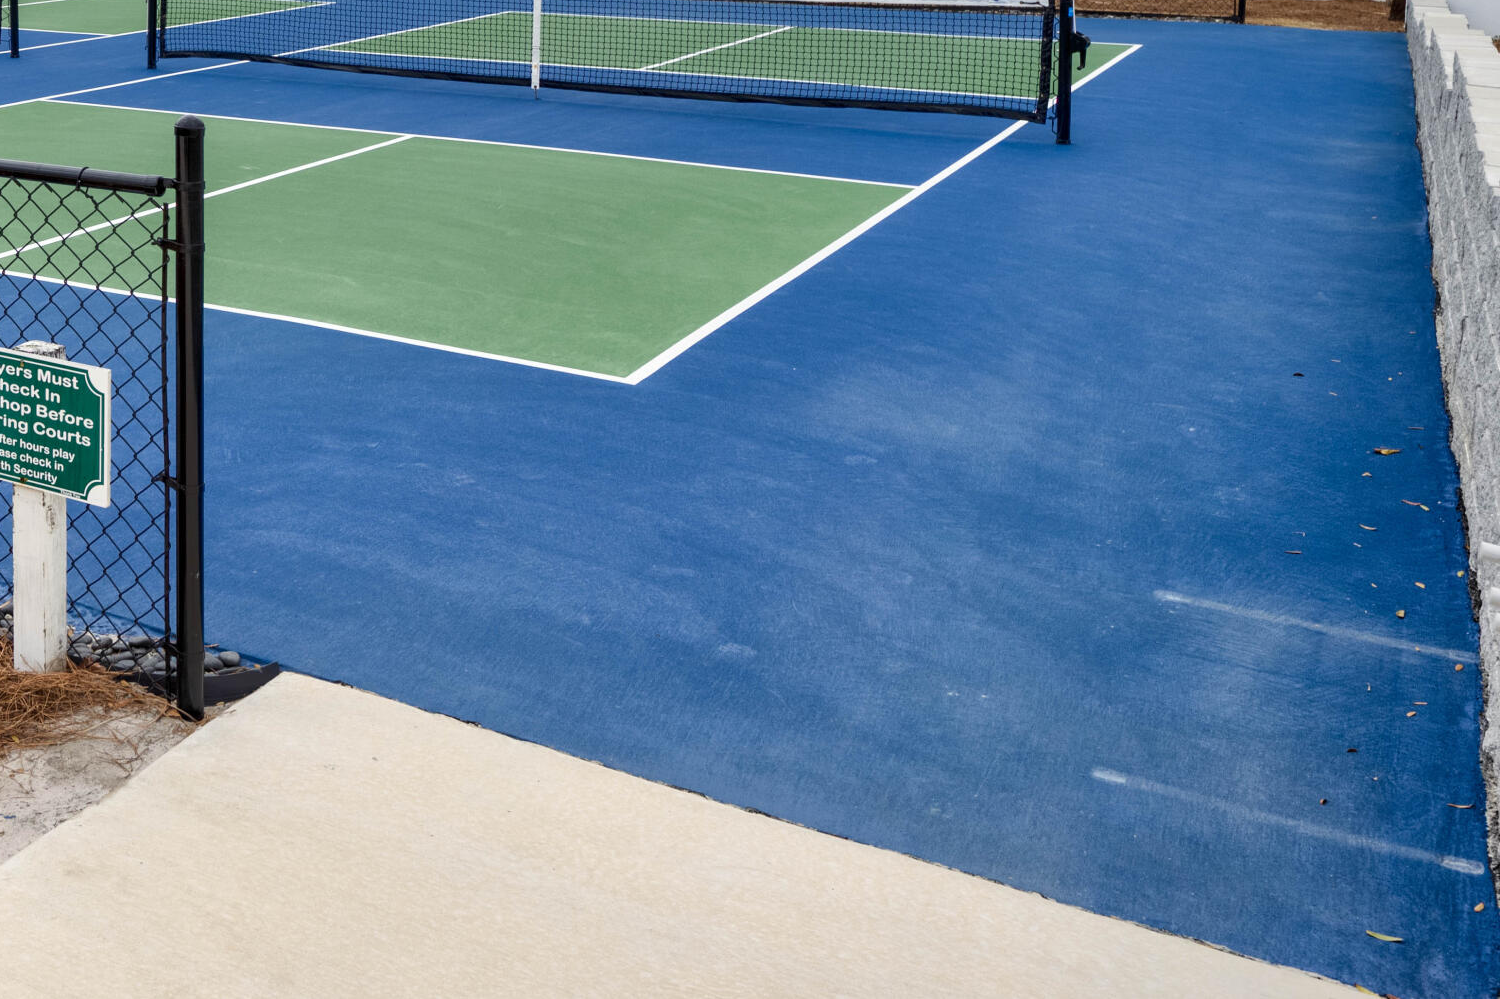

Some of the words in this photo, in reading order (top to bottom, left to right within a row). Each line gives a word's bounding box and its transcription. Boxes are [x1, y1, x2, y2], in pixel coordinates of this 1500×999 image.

[38, 369, 79, 389] Must
[46, 388, 60, 403] In
[36, 405, 93, 429] Before
[33, 423, 91, 446] Courts
[20, 439, 49, 454] hours
[53, 448, 75, 462] play
[20, 451, 51, 468] check
[55, 461, 64, 471] in
[14, 464, 57, 484] Security
